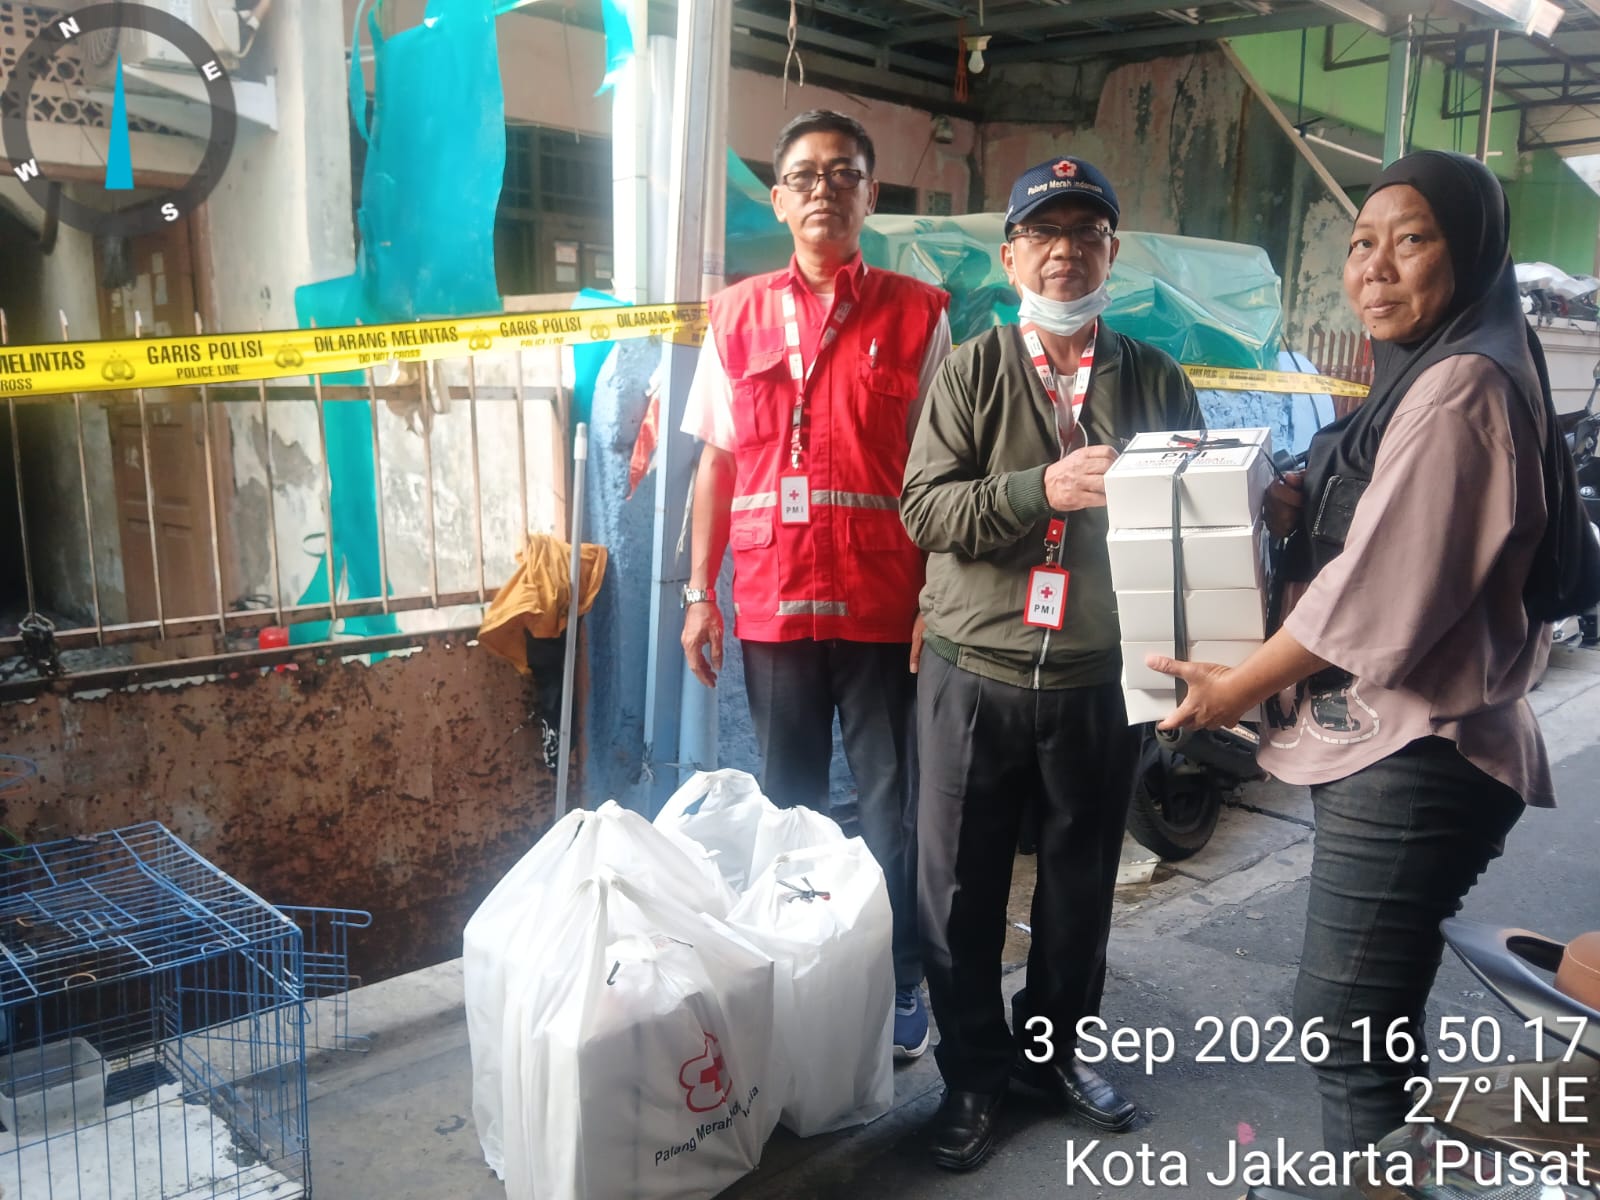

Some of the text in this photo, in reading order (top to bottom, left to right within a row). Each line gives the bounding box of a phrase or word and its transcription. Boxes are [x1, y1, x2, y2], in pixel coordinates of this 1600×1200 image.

[500, 316, 582, 337] GARIS POLISI
[616, 310, 671, 328] DILARANG
[314, 326, 459, 353] DILARANG MELINTAS
[147, 339, 263, 365] GARIS POLISI
[358, 353, 370, 363] DO
[176, 364, 240, 379] POLICE LINE
[0, 378, 32, 392] ROSS
[785, 505, 804, 514] PMI
[1034, 604, 1055, 615] PMI
[655, 1136, 697, 1166] Palang
[696, 1117, 733, 1140] Merah
